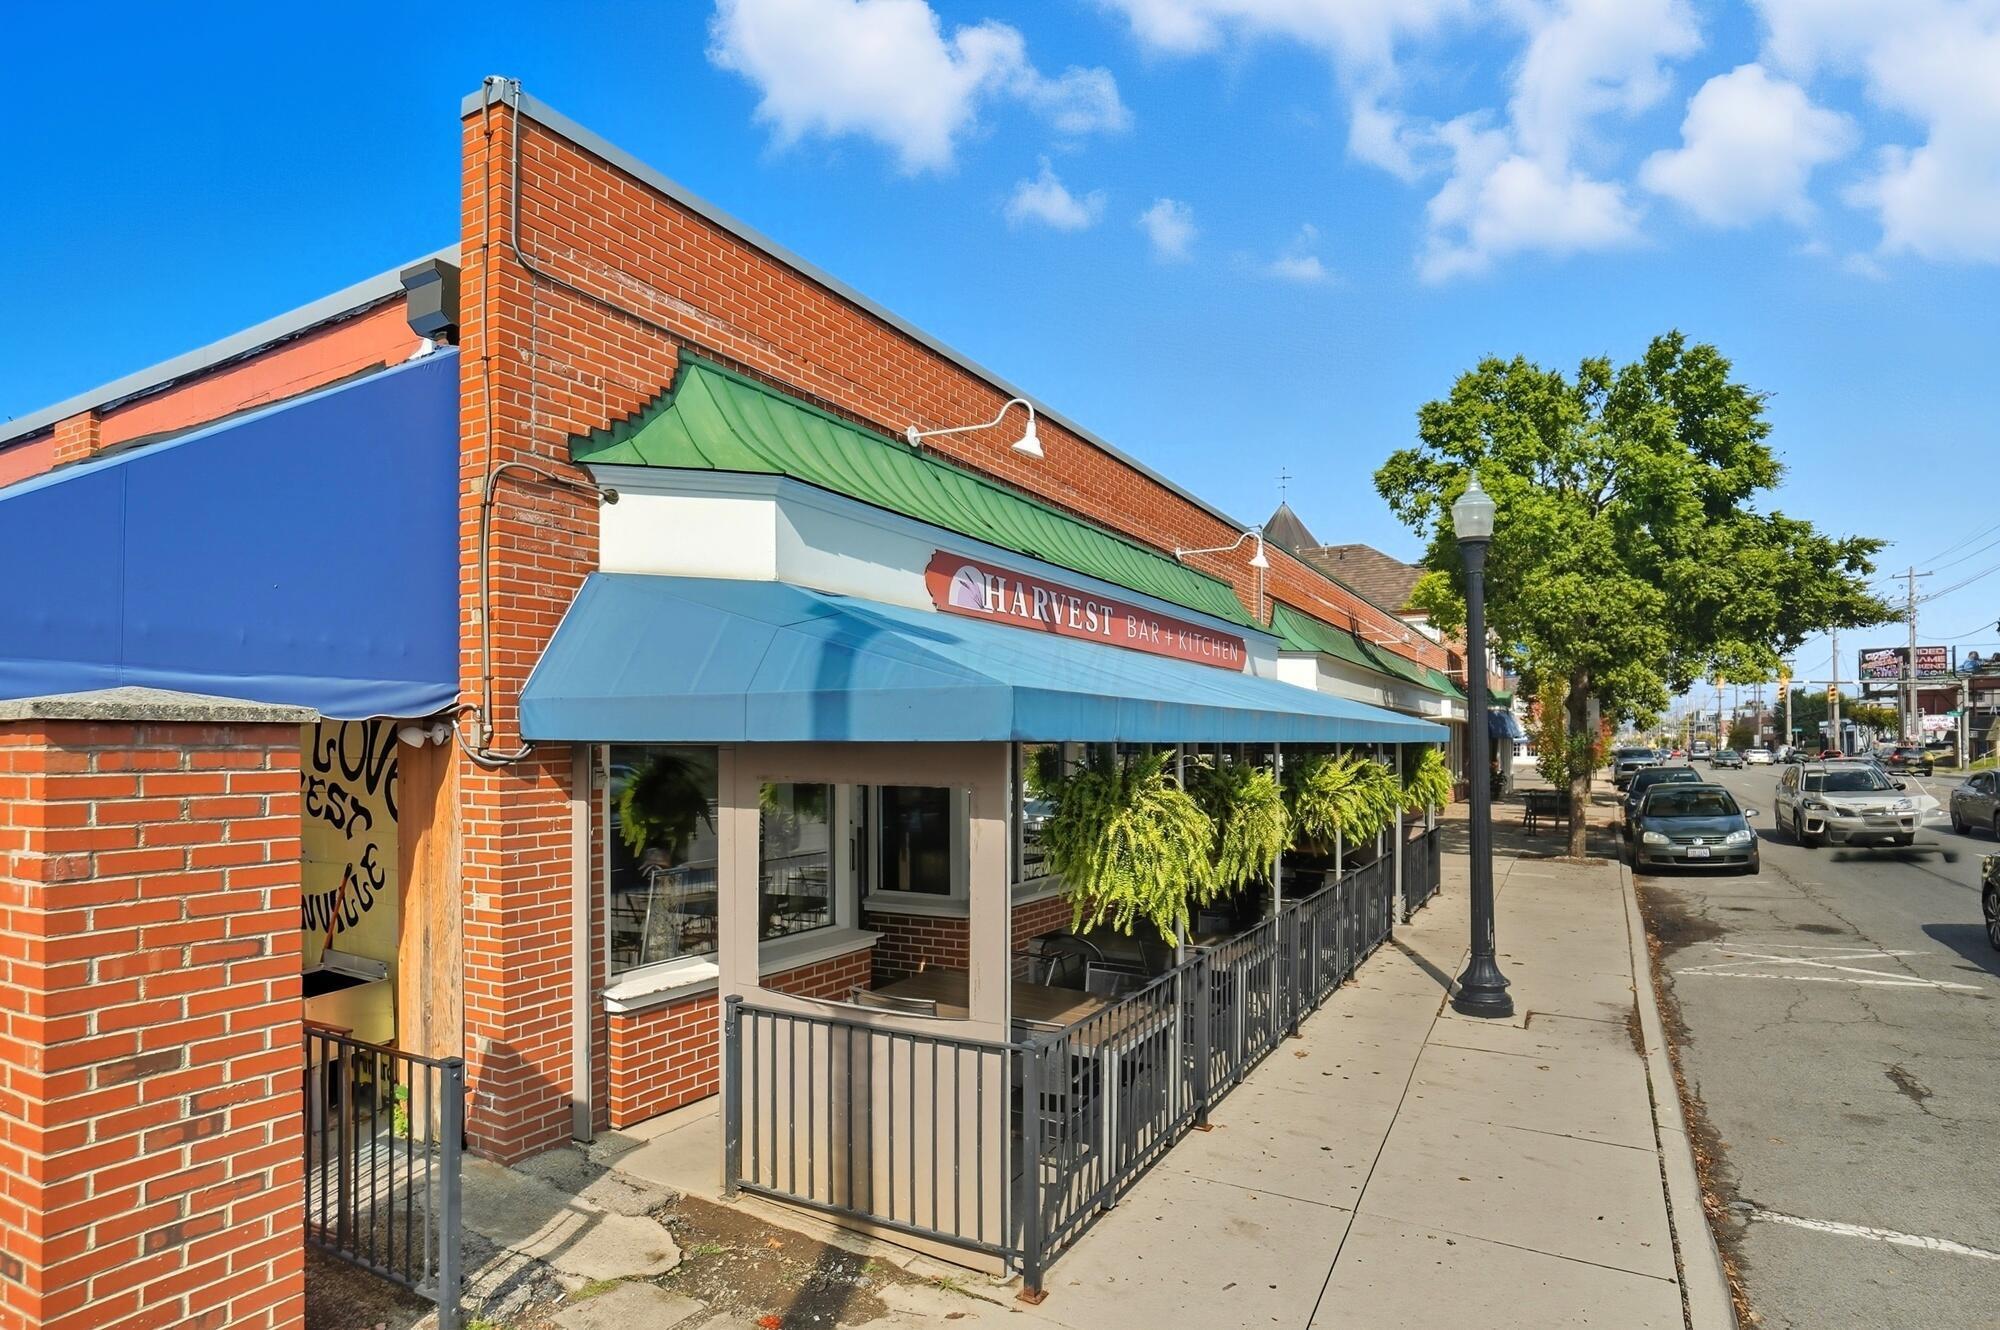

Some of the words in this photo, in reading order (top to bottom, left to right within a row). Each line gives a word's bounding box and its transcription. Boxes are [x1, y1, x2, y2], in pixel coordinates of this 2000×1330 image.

[983, 572, 1113, 636] HARVEST
[1127, 614, 1160, 645] BAR
[1179, 629, 1239, 662] KITCHEN
[301, 843, 385, 934] NVILLE
